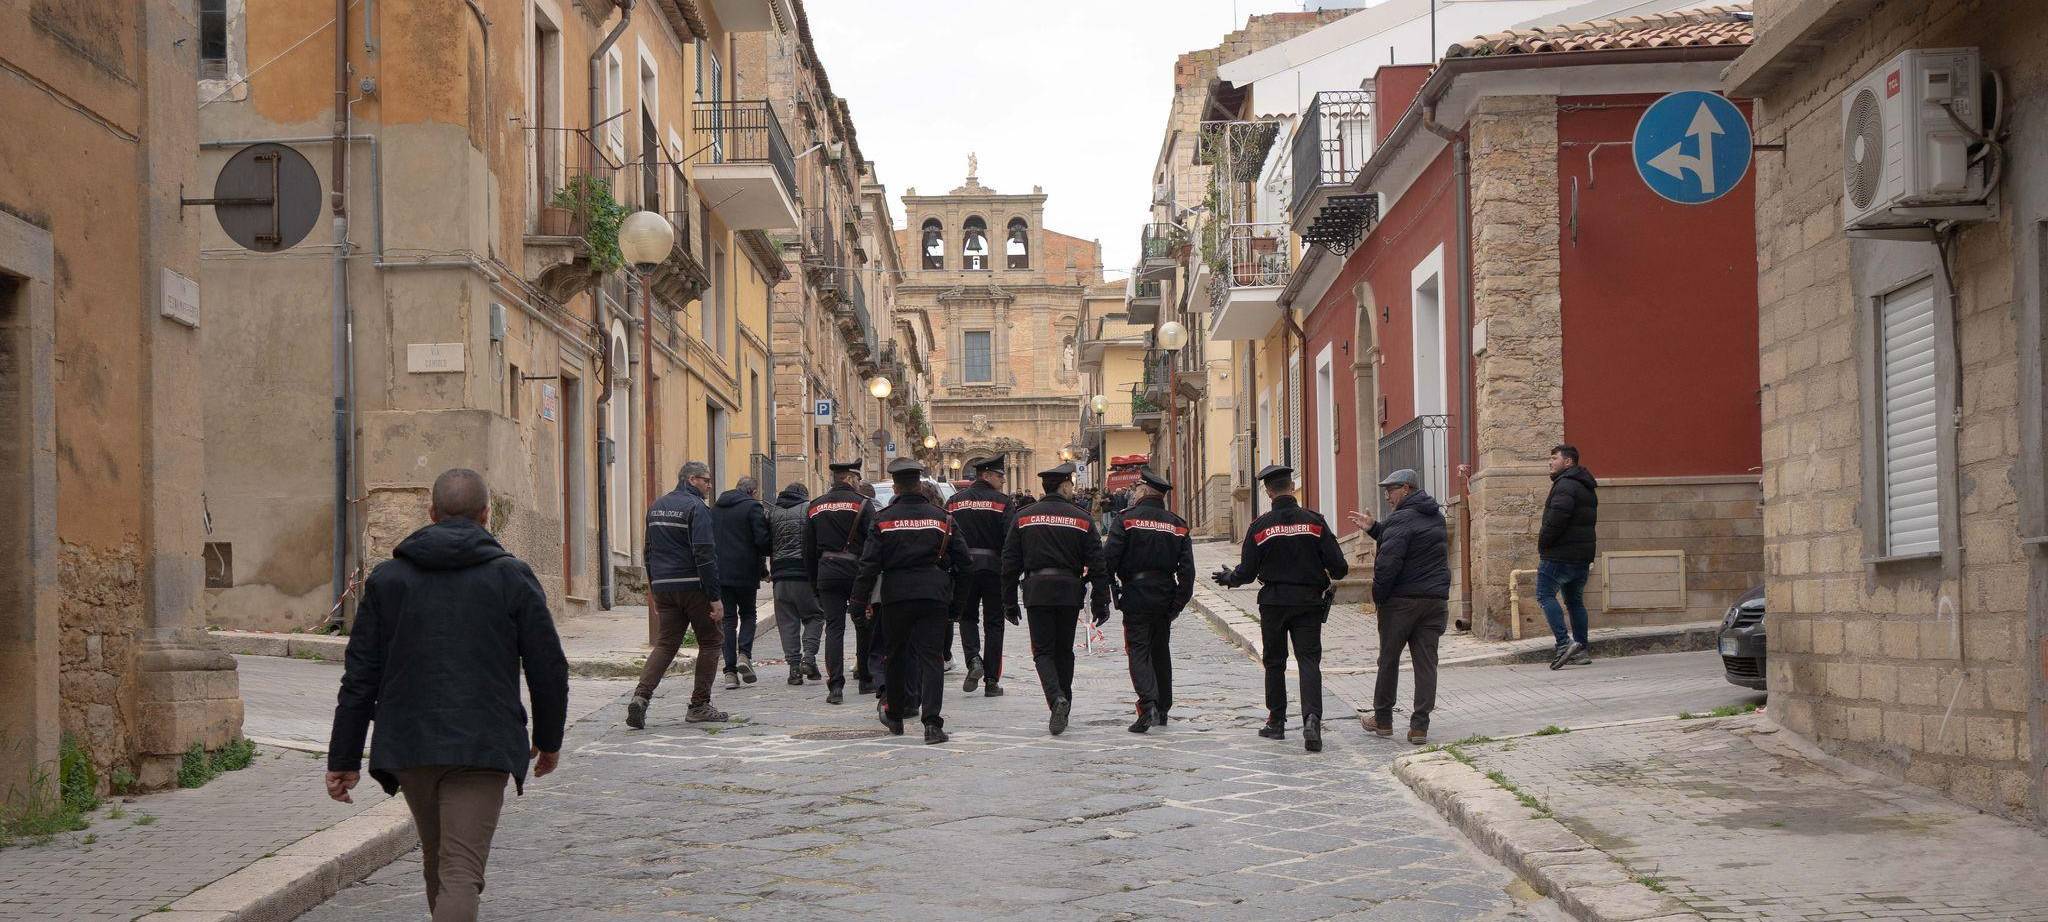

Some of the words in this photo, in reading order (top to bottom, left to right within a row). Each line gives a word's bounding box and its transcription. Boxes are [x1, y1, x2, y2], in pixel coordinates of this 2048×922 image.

[1888, 79, 1898, 90] TCL
[819, 404, 827, 414] P
[816, 502, 853, 511] CARABINIERI
[957, 500, 993, 508] CARABINIERI
[665, 510, 684, 518] LOCALE
[894, 519, 940, 528] CARABINIERI
[1030, 515, 1077, 526] CARABINIERI
[1135, 519, 1177, 532] CARABINIERI
[1265, 524, 1310, 536] CARABINIERI
